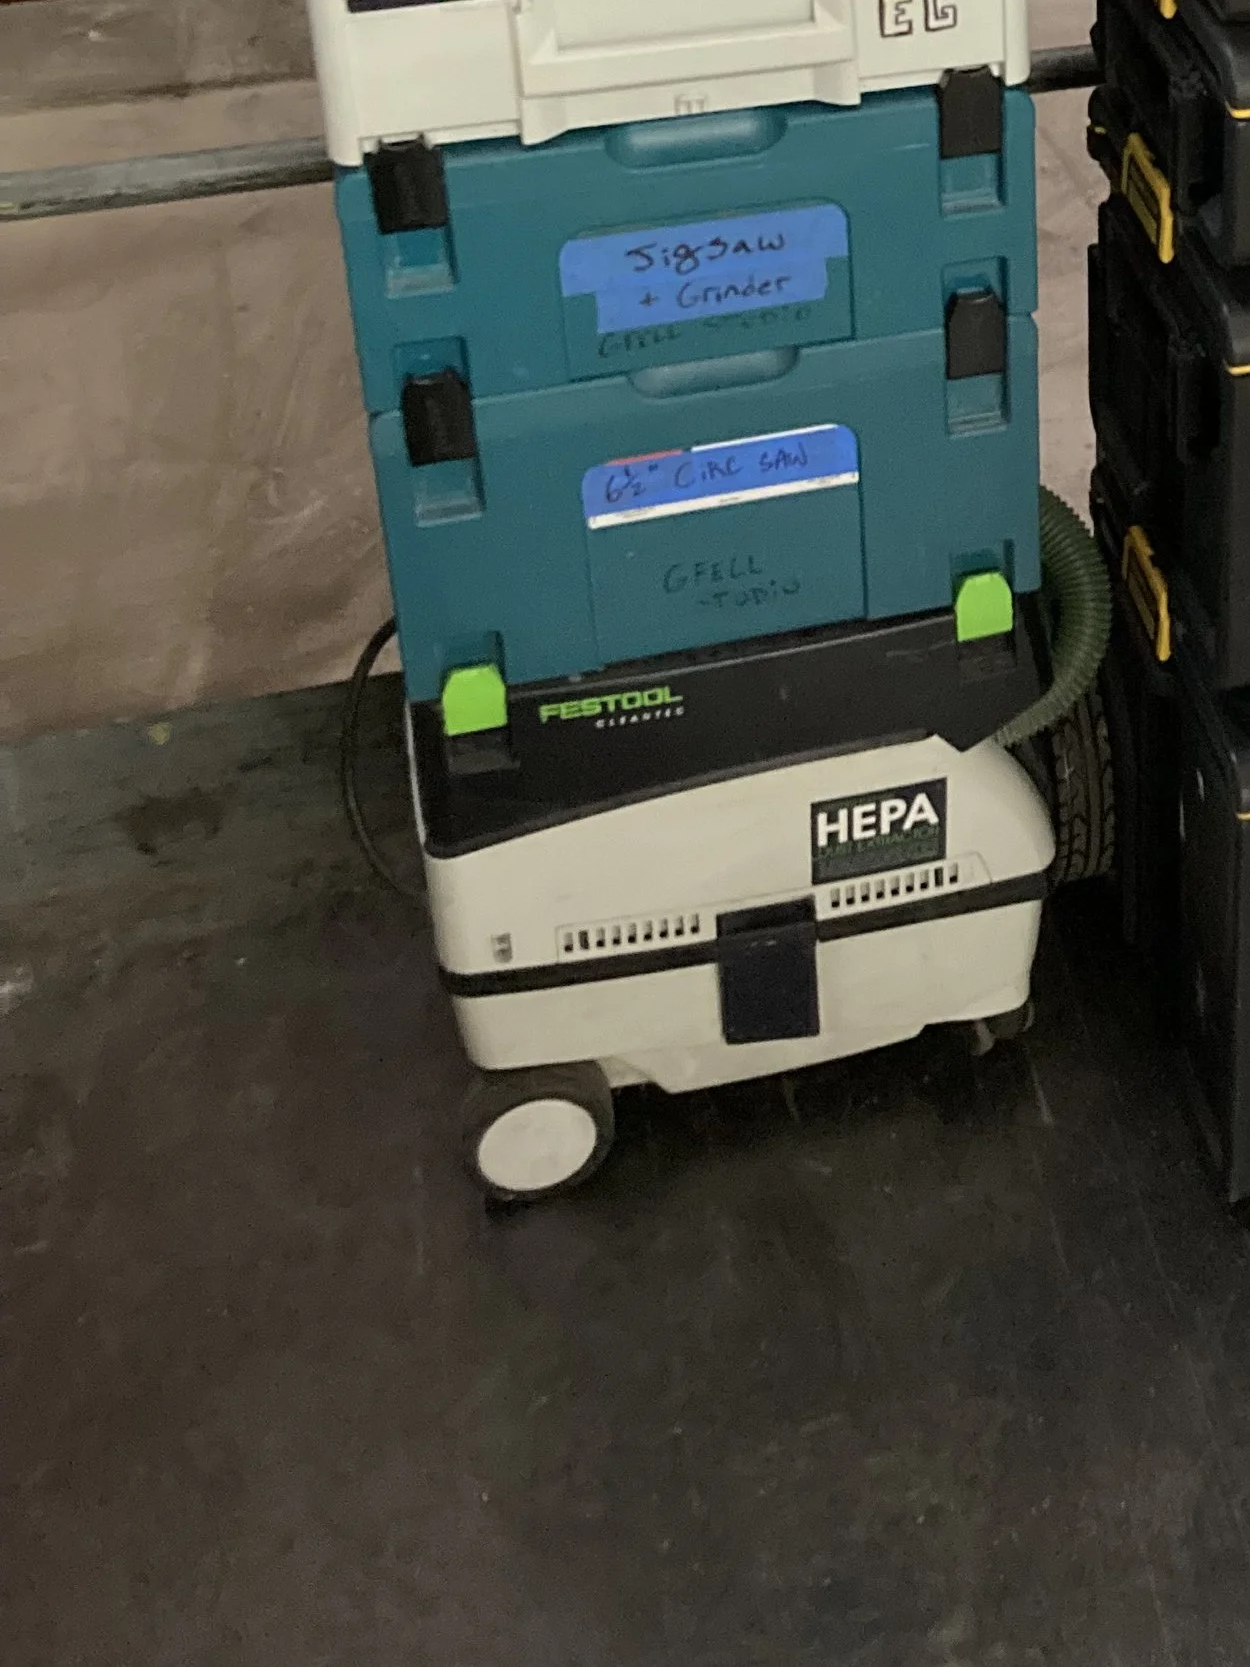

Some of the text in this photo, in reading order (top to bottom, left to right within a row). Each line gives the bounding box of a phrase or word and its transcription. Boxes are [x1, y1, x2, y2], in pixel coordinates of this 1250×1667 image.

[625, 231, 786, 276] Jigsaw
[639, 274, 792, 309] + Grinder
[757, 441, 809, 473] SAW
[538, 686, 684, 724] FESTOOL
[817, 792, 939, 847] HEPA
